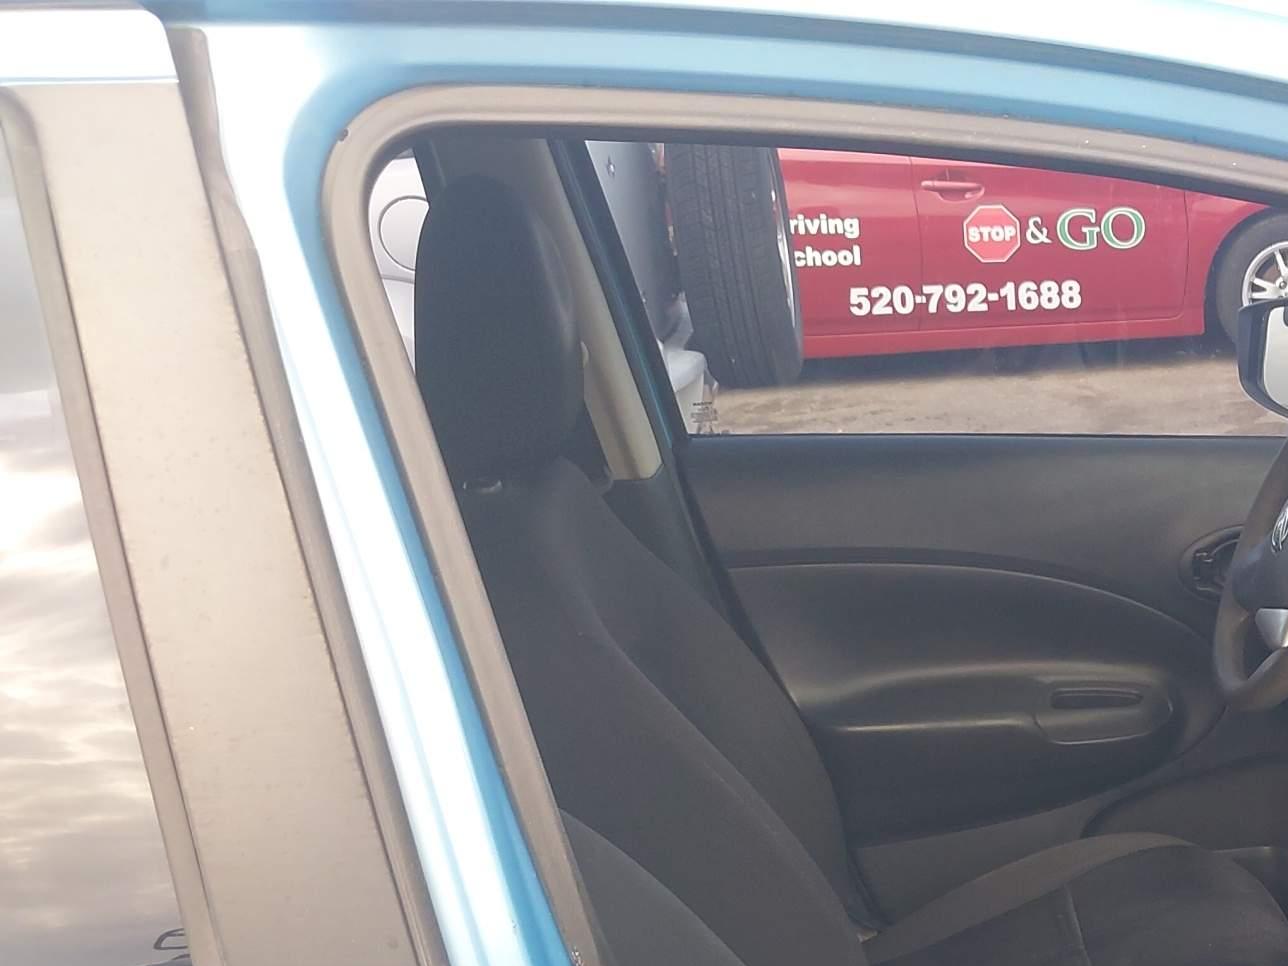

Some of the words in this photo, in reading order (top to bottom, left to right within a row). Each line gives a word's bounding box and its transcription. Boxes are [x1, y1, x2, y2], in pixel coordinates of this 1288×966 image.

[789, 213, 860, 239] riving
[968, 225, 1017, 243] STOP
[1026, 215, 1052, 244] &
[1056, 206, 1146, 250] GO
[794, 244, 861, 267] chool
[849, 280, 1082, 316] 520-792-1688
